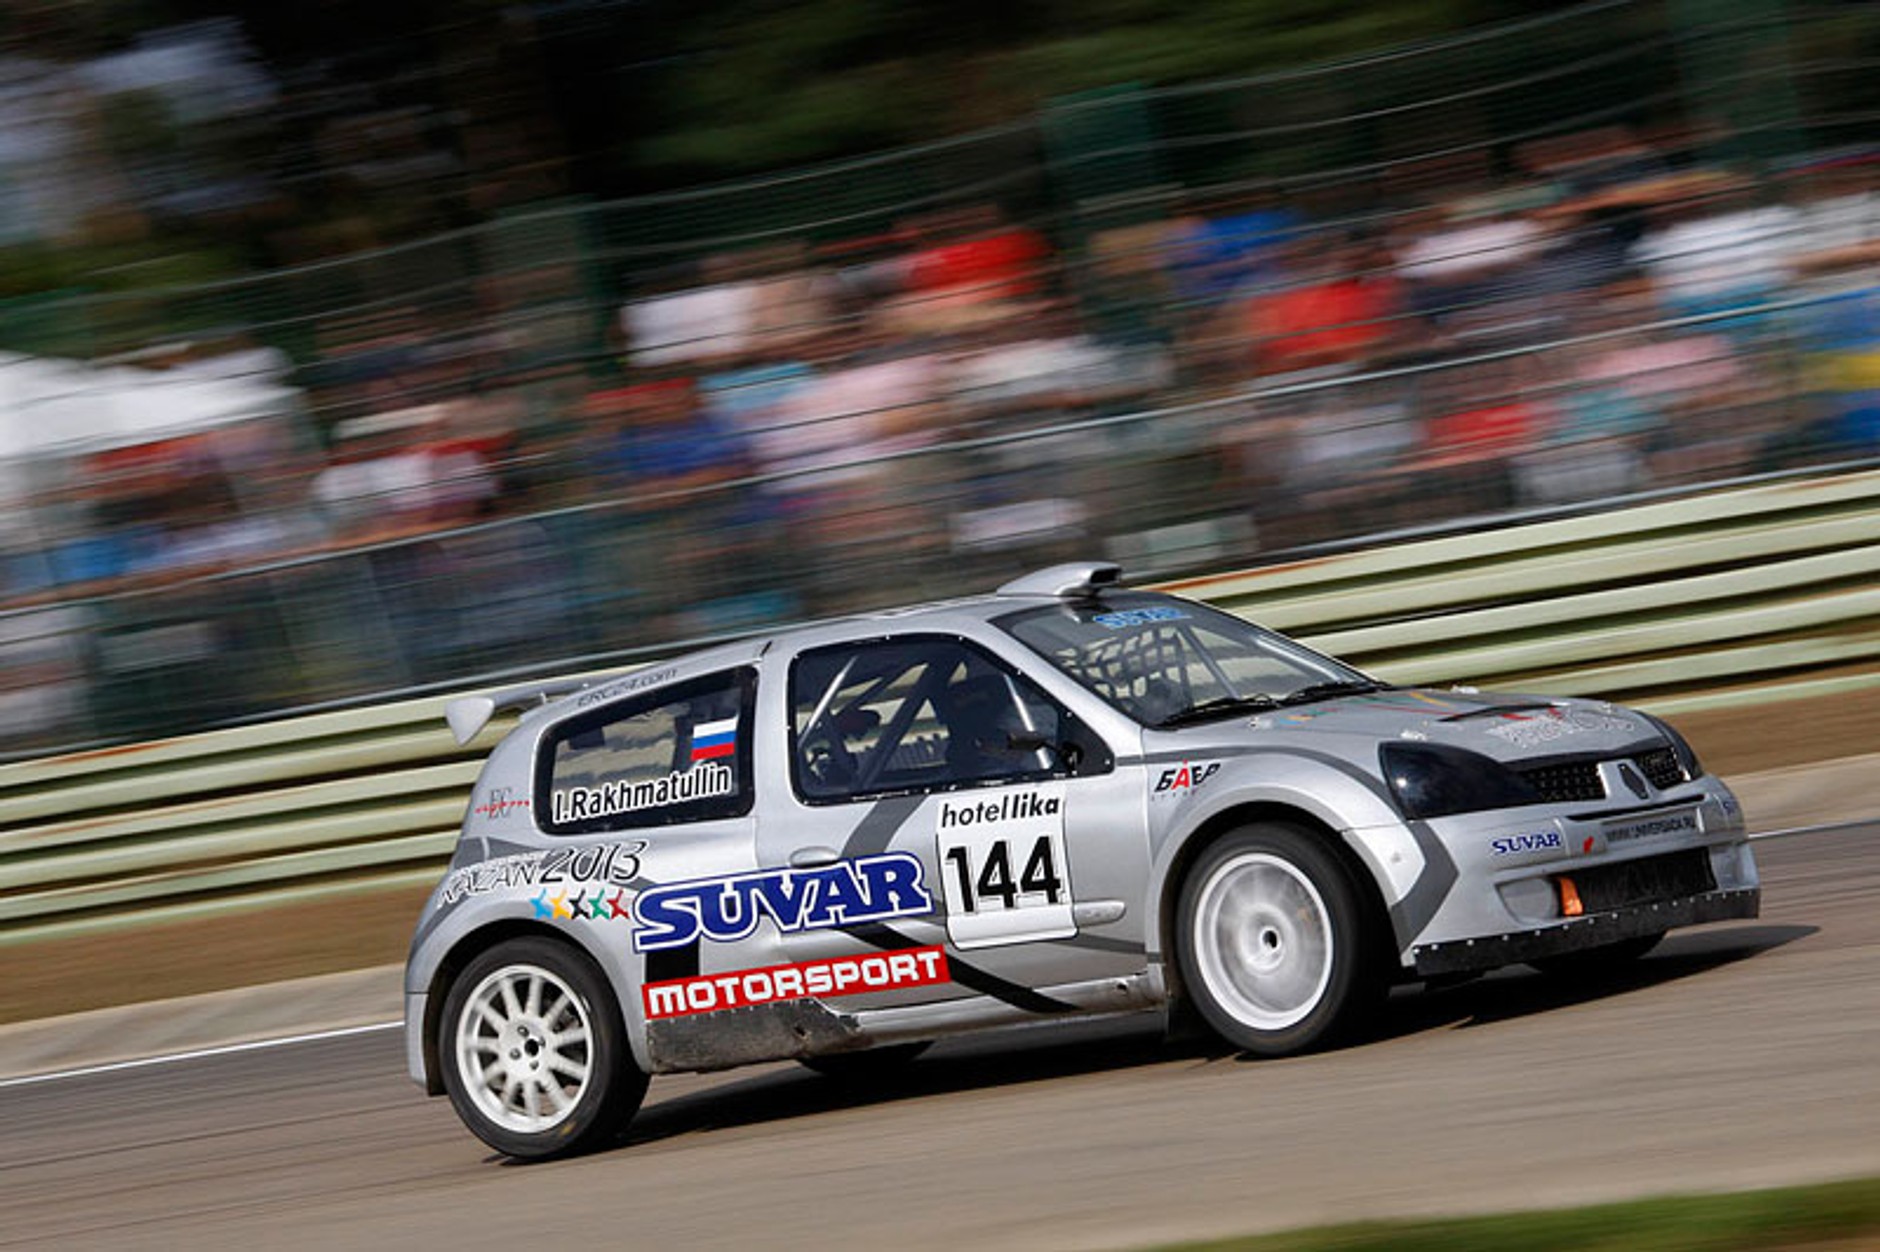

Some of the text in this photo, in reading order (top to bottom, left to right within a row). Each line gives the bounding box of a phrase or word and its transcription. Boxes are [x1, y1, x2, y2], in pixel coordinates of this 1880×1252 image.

[552, 765, 733, 825] I.Rakhmatullin
[947, 835, 1062, 913] 144
[1492, 833, 1561, 853] SUVAR
[634, 851, 934, 952] SUVAR
[648, 951, 942, 1014] MOTORSPORT
